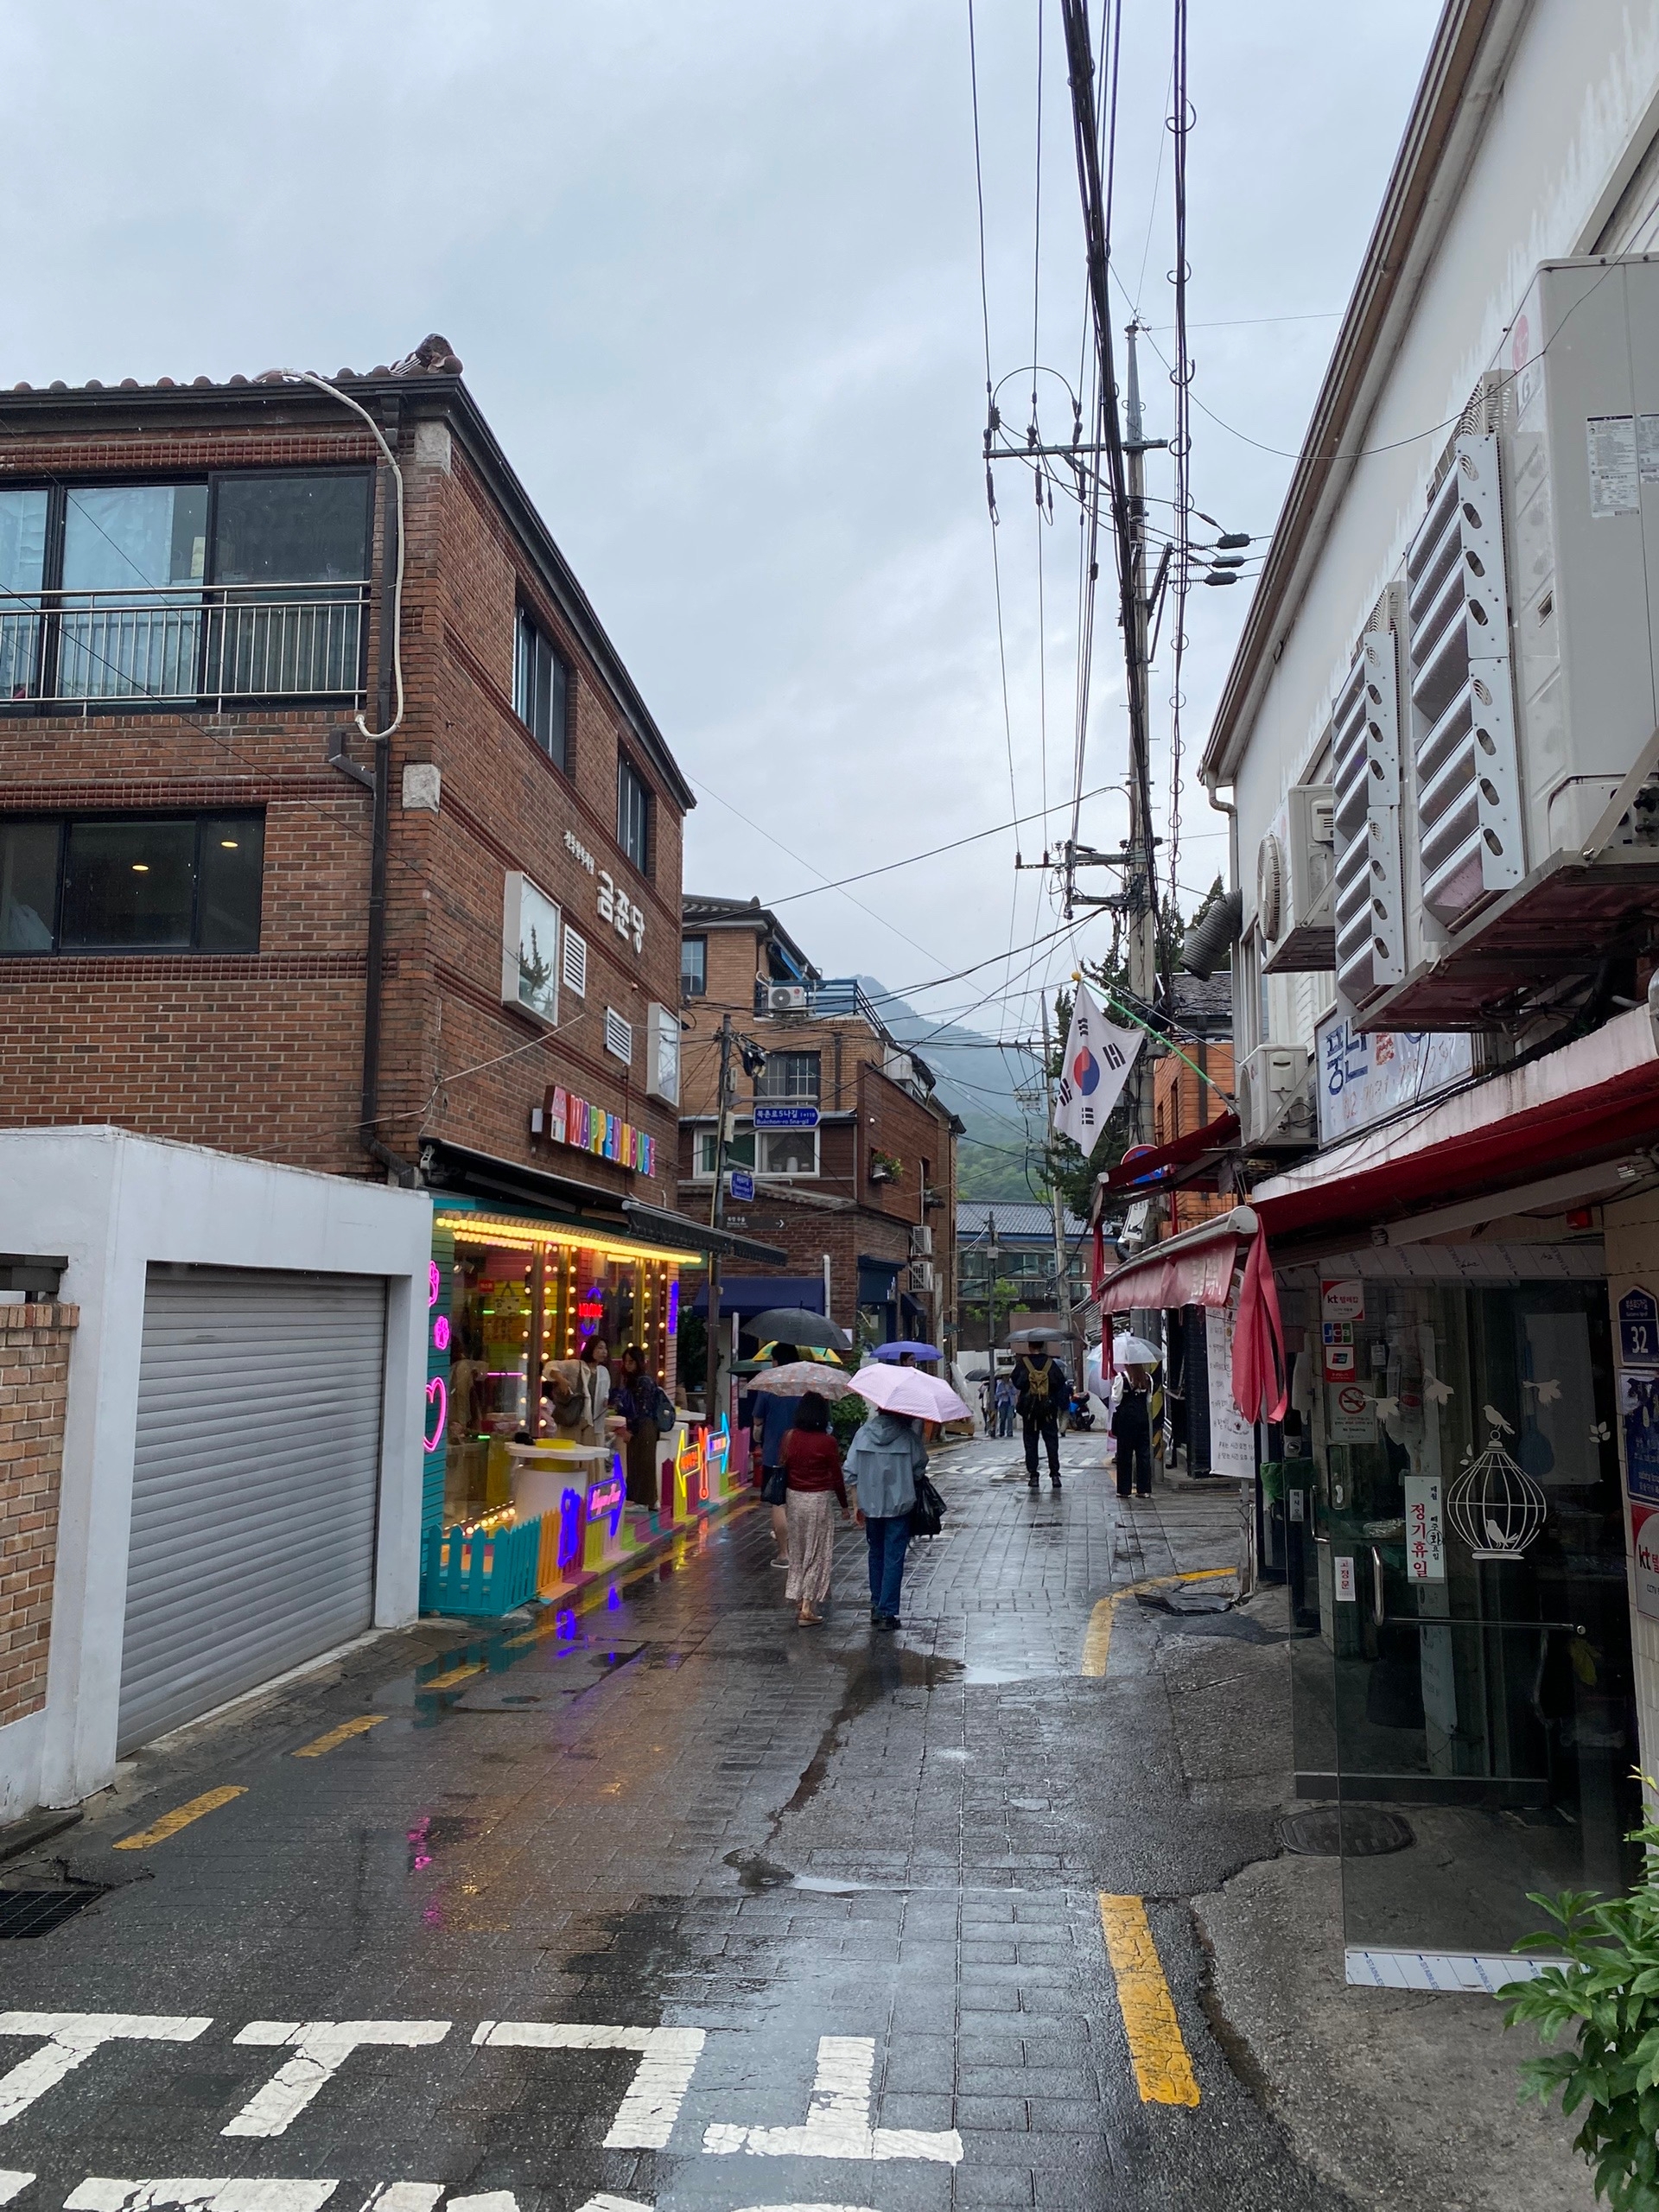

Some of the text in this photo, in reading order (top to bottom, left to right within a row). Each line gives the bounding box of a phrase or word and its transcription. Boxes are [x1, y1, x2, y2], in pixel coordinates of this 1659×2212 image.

[757, 1109, 798, 1119] 북촌로5나길
[1327, 1294, 1338, 1303] kt
[1325, 1328, 1351, 1338] JCB
[1630, 1325, 1649, 1354] 32
[1410, 1503, 1428, 1578] 정기휴일
[1638, 1544, 1651, 1571] kt
[1340, 1560, 1350, 1590] 고정문
